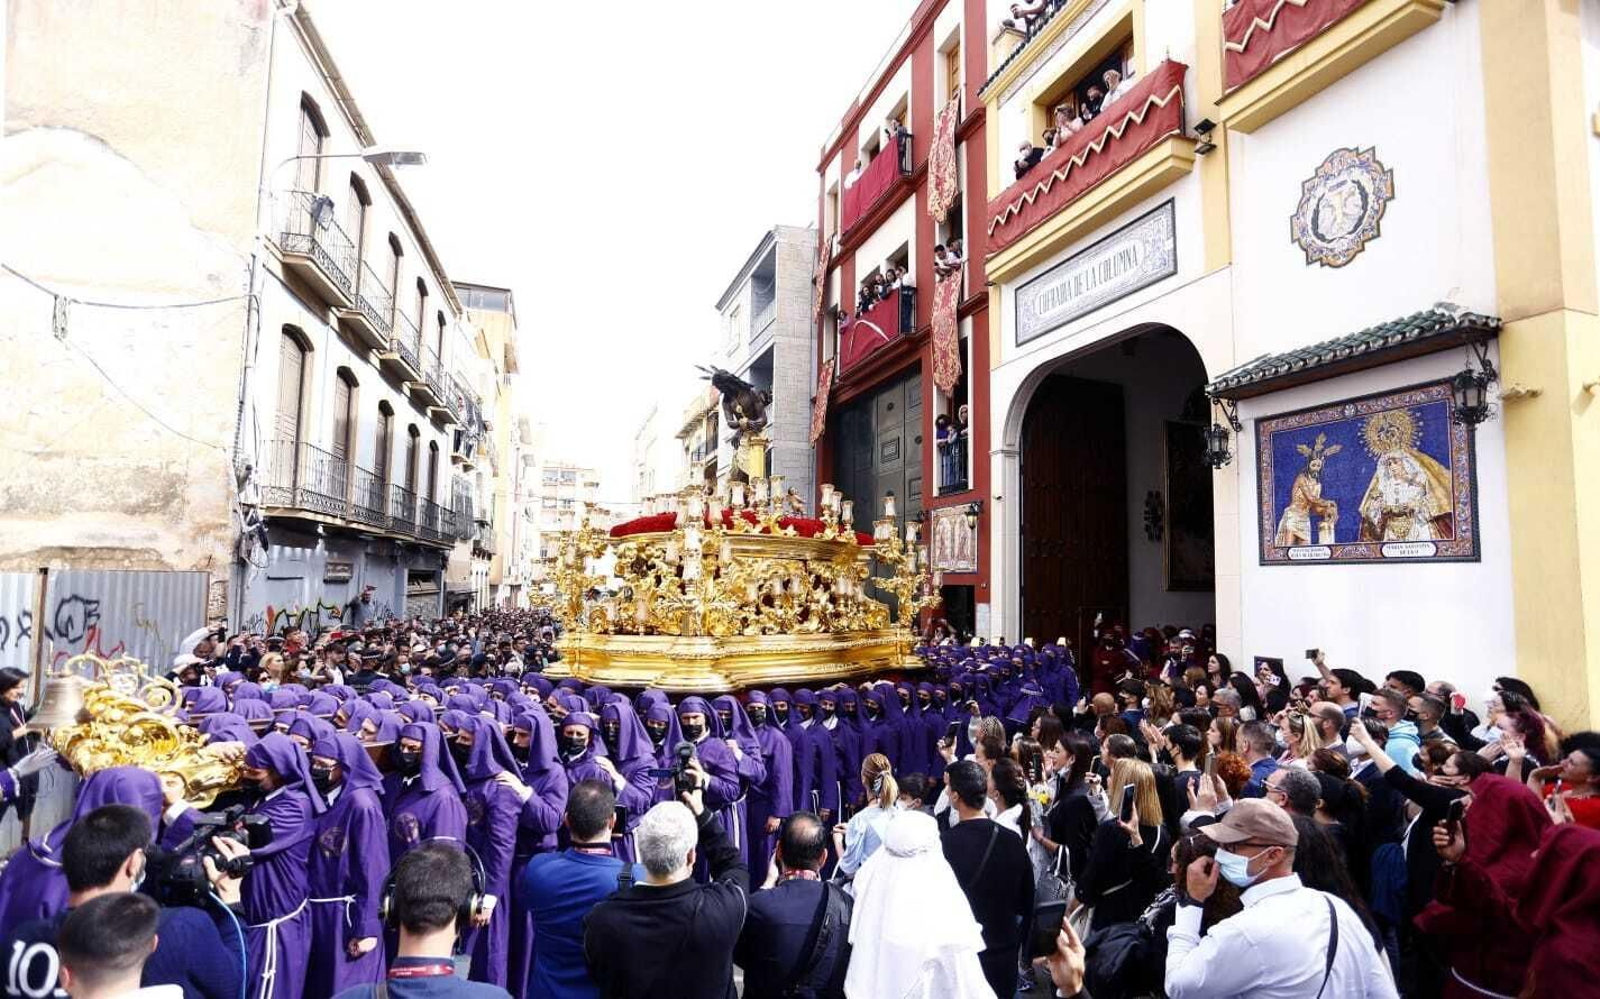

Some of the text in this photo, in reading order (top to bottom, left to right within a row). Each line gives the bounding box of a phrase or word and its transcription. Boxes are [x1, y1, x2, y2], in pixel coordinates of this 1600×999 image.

[1074, 273, 1083, 296] DE
[1086, 266, 1097, 291] LA
[1099, 244, 1138, 284] COLUMNA
